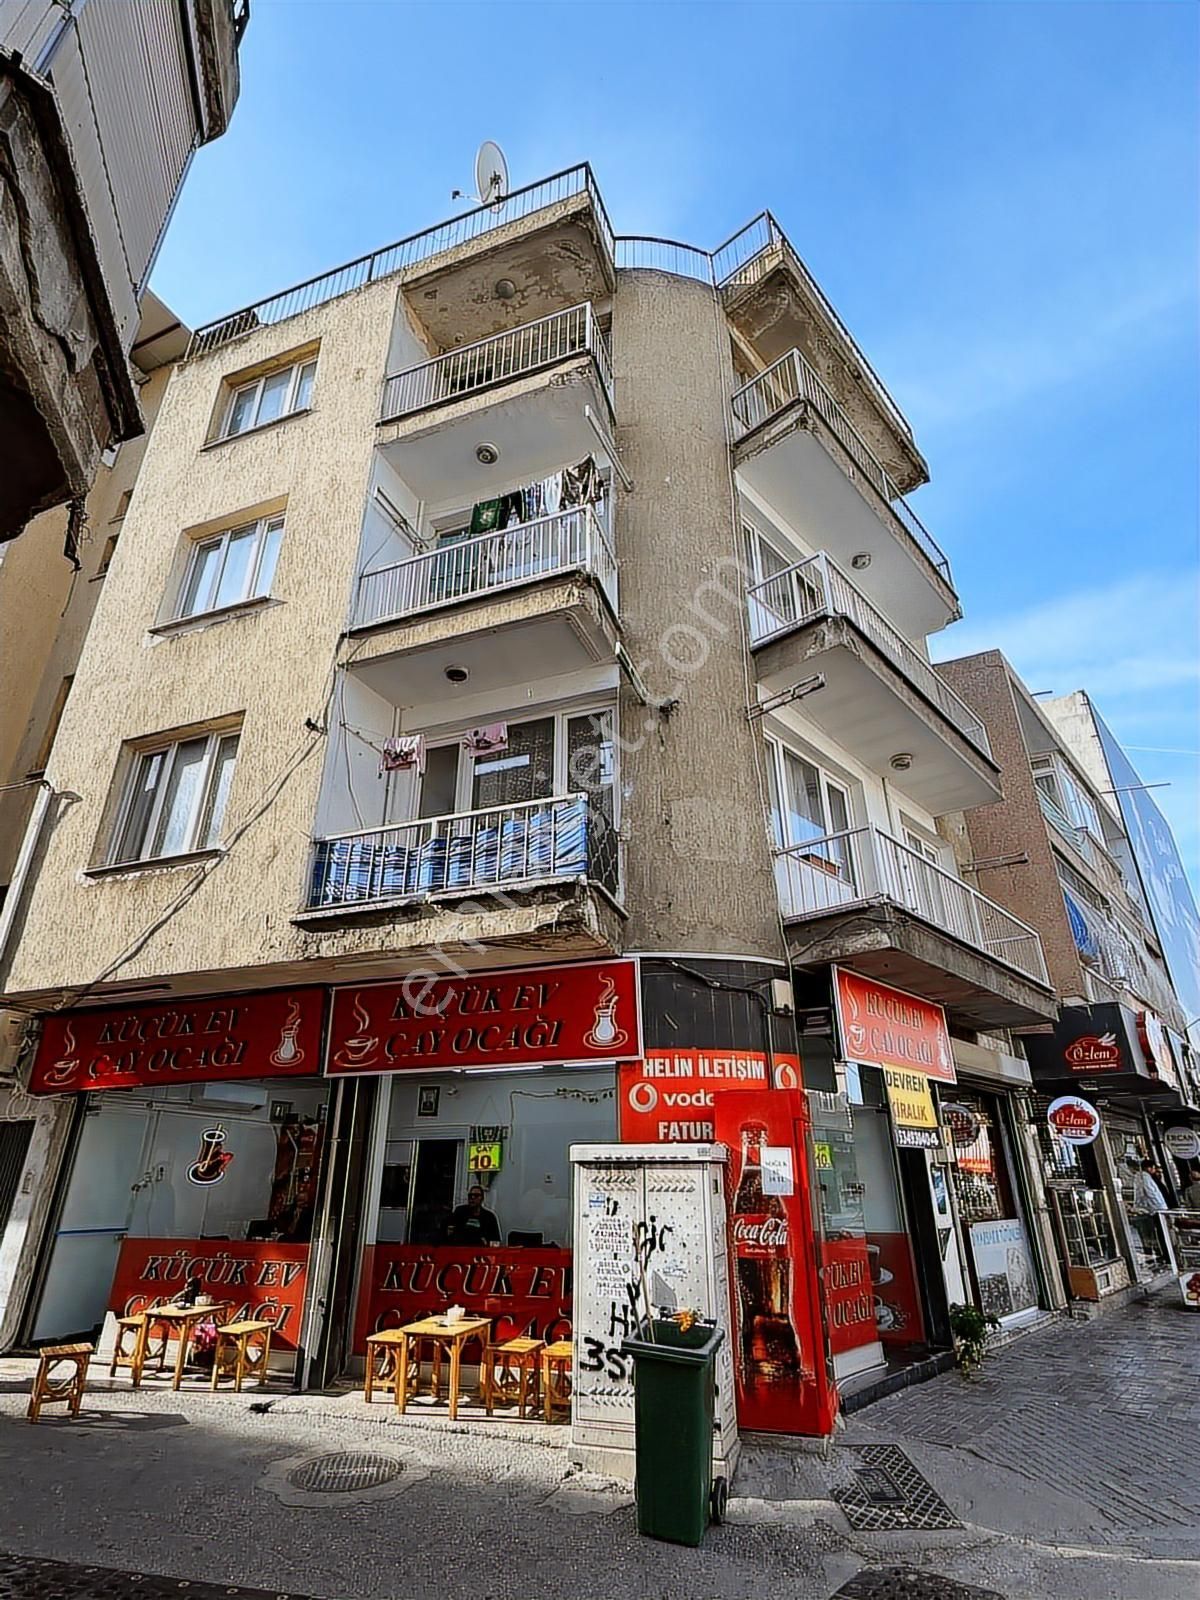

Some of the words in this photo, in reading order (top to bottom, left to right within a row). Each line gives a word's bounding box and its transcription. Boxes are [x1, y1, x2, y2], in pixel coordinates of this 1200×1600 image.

[386, 984, 502, 1023] KÜÇÜK
[511, 981, 560, 1012] EV
[95, 1010, 197, 1045] KÜÇÜK
[202, 1007, 250, 1034] EV
[384, 1029, 447, 1064] ÇAY
[452, 1014, 566, 1055] OCAĞI
[87, 1051, 145, 1081] ÇAY
[148, 1034, 244, 1073] OCAĞI
[643, 1054, 693, 1078] HELİN
[698, 1055, 766, 1081] İLETİŞİM
[885, 1071, 926, 1094] DEVREN
[255, 1261, 304, 1288] EV
[380, 1256, 516, 1301] KÜÇÜK
